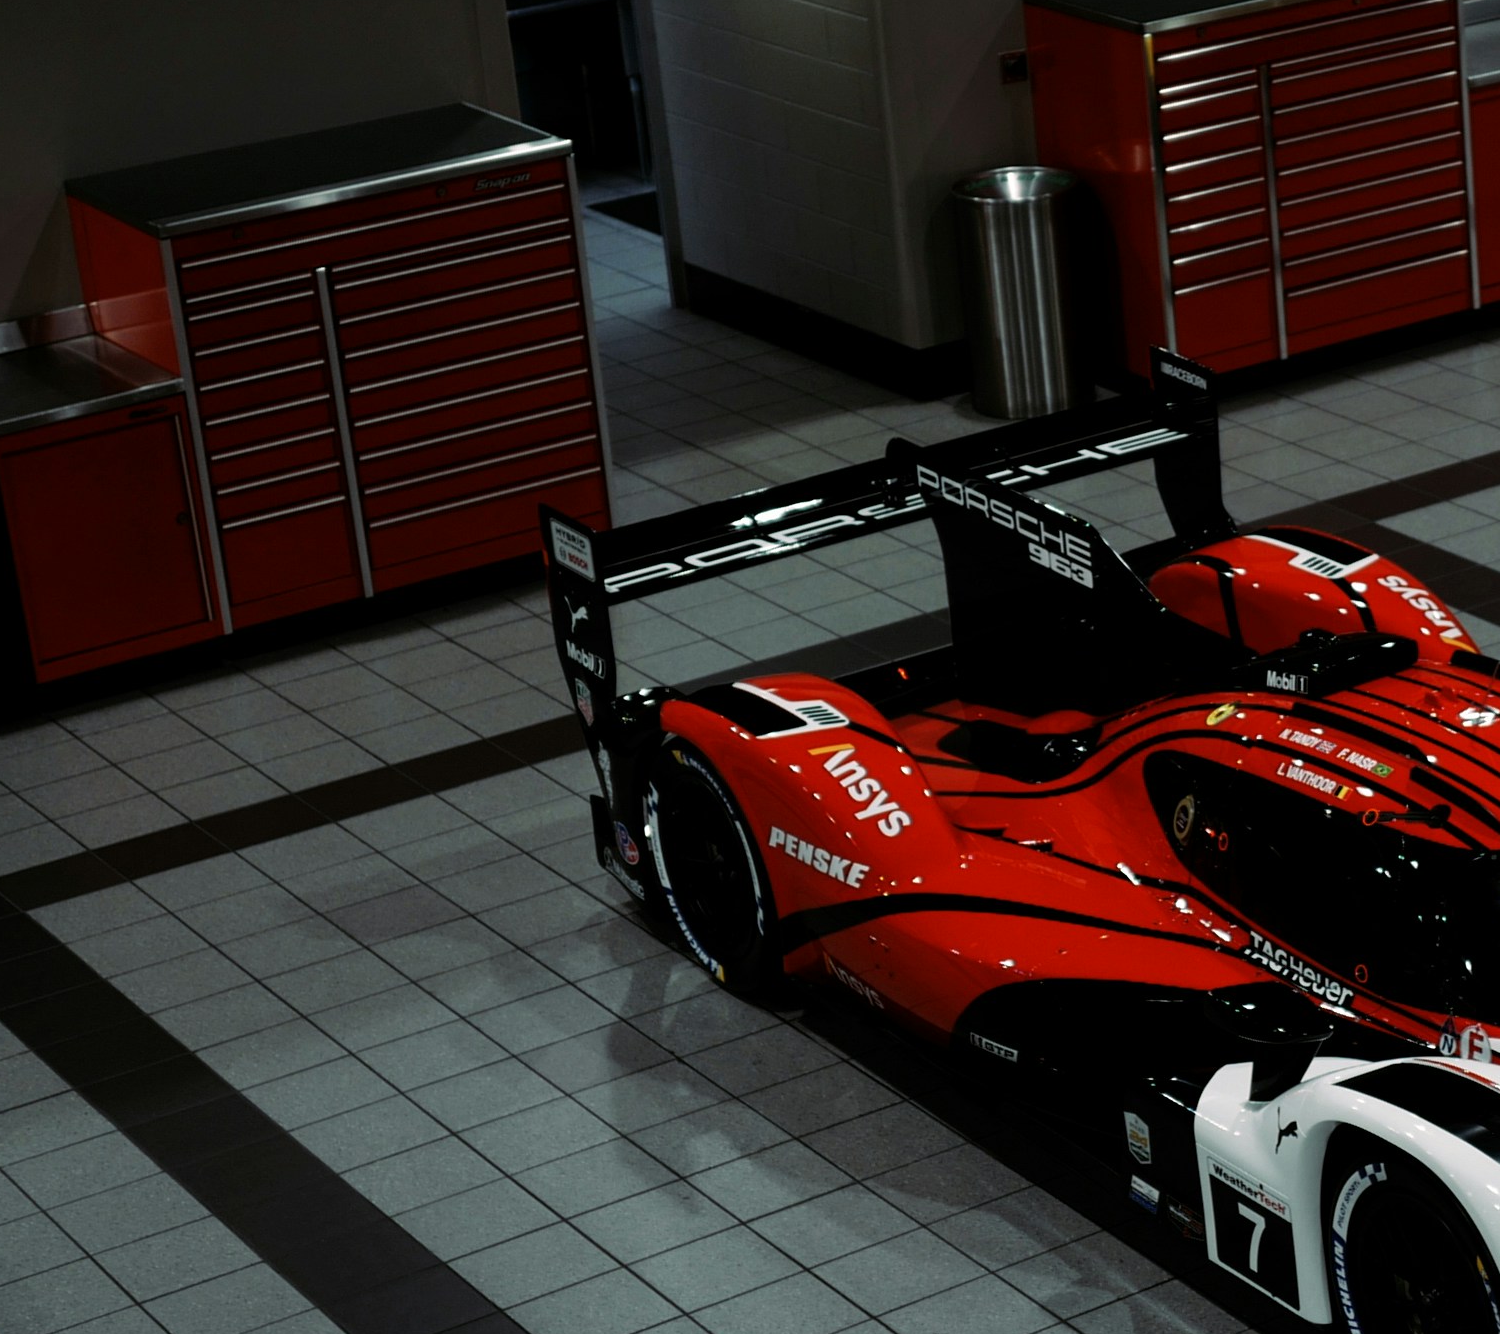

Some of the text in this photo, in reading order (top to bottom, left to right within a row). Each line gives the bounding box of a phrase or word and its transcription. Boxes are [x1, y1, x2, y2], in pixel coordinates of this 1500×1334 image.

[555, 526, 587, 549] HYBRID
[917, 463, 1093, 567] PORSCHE
[567, 553, 589, 570] BOSCH
[1028, 542, 1094, 589] 963
[566, 639, 596, 672] Mobil
[1266, 669, 1296, 691] Mobil
[808, 743, 912, 839] Ansys
[1288, 767, 1337, 794] VANTHOOR
[769, 826, 870, 889] PENSKE
[1211, 1163, 1287, 1216] WeatherTech
[1237, 1201, 1267, 1273] 7
